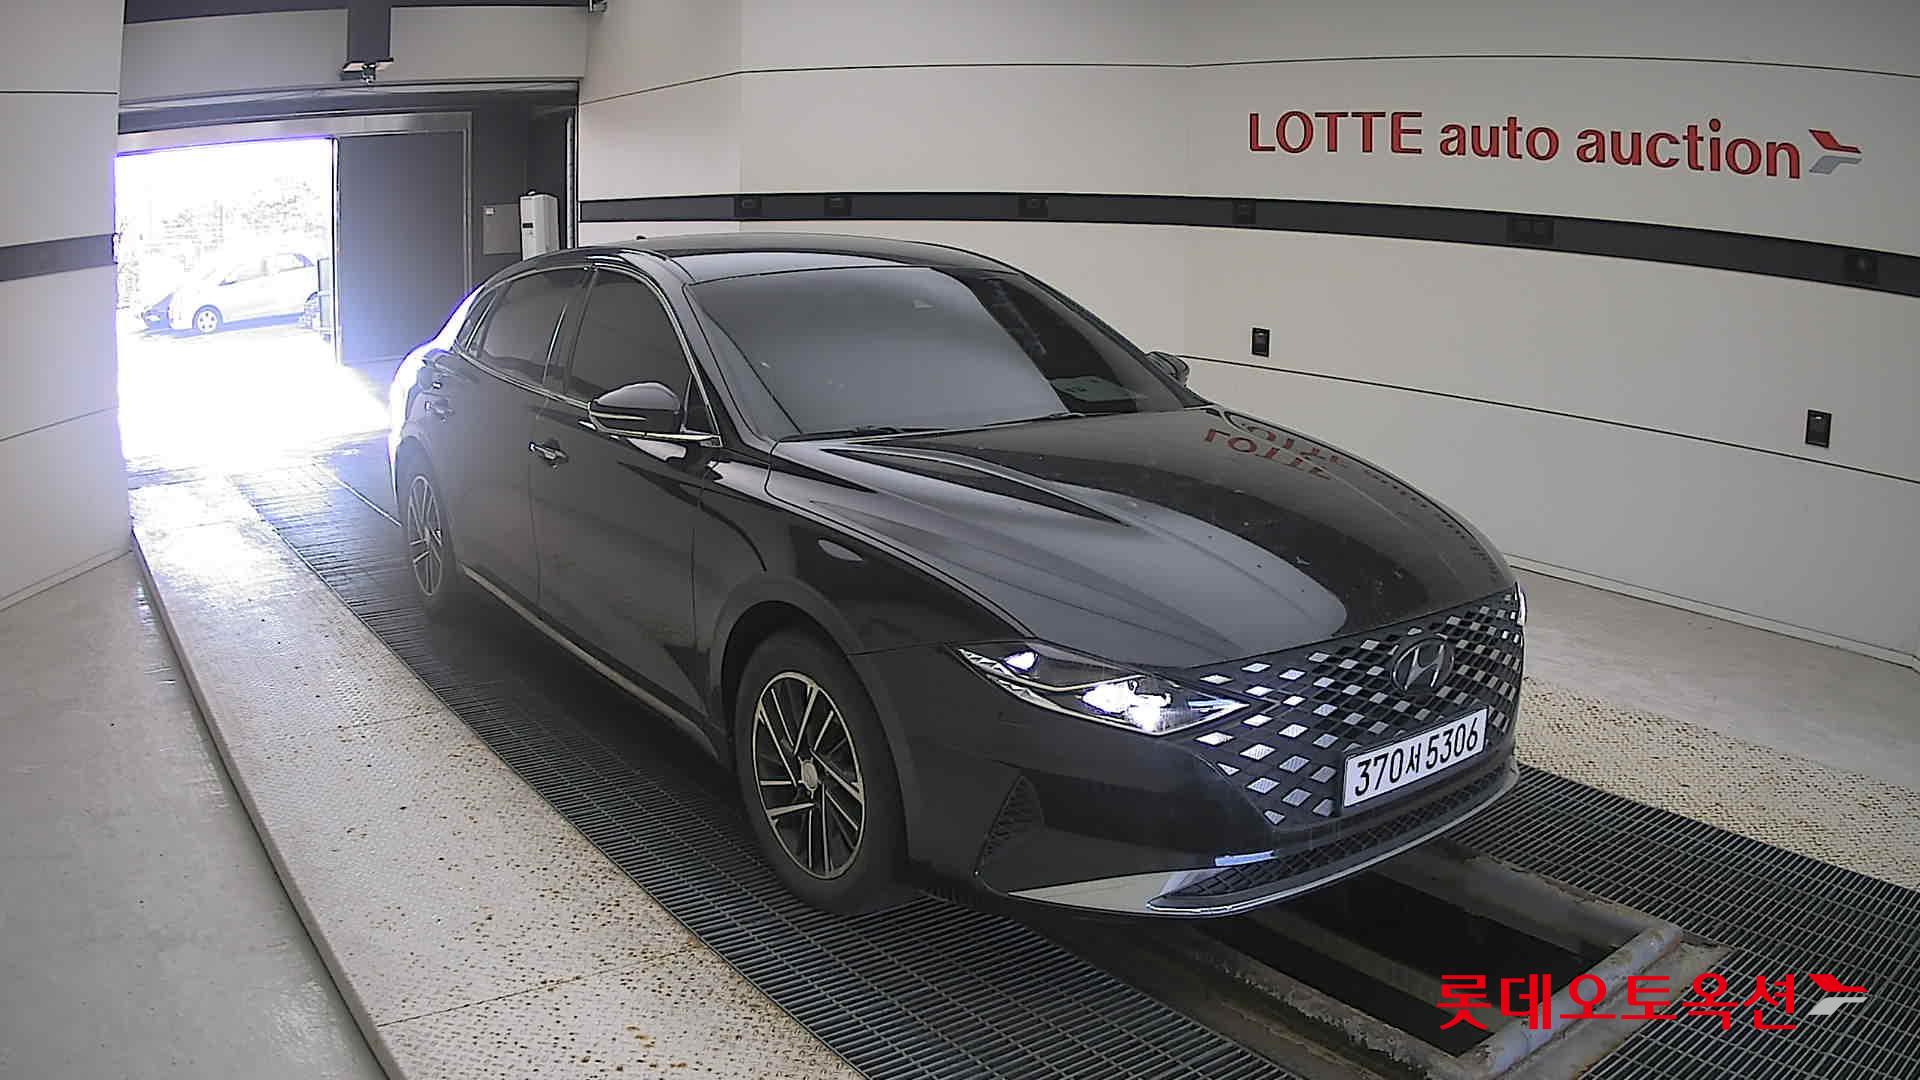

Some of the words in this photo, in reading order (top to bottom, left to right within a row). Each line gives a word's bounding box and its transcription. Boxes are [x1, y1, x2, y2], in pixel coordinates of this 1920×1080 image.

[1248, 111, 1423, 155] LOTTE
[1440, 116, 1560, 160] auto
[1576, 118, 1801, 179] auction
